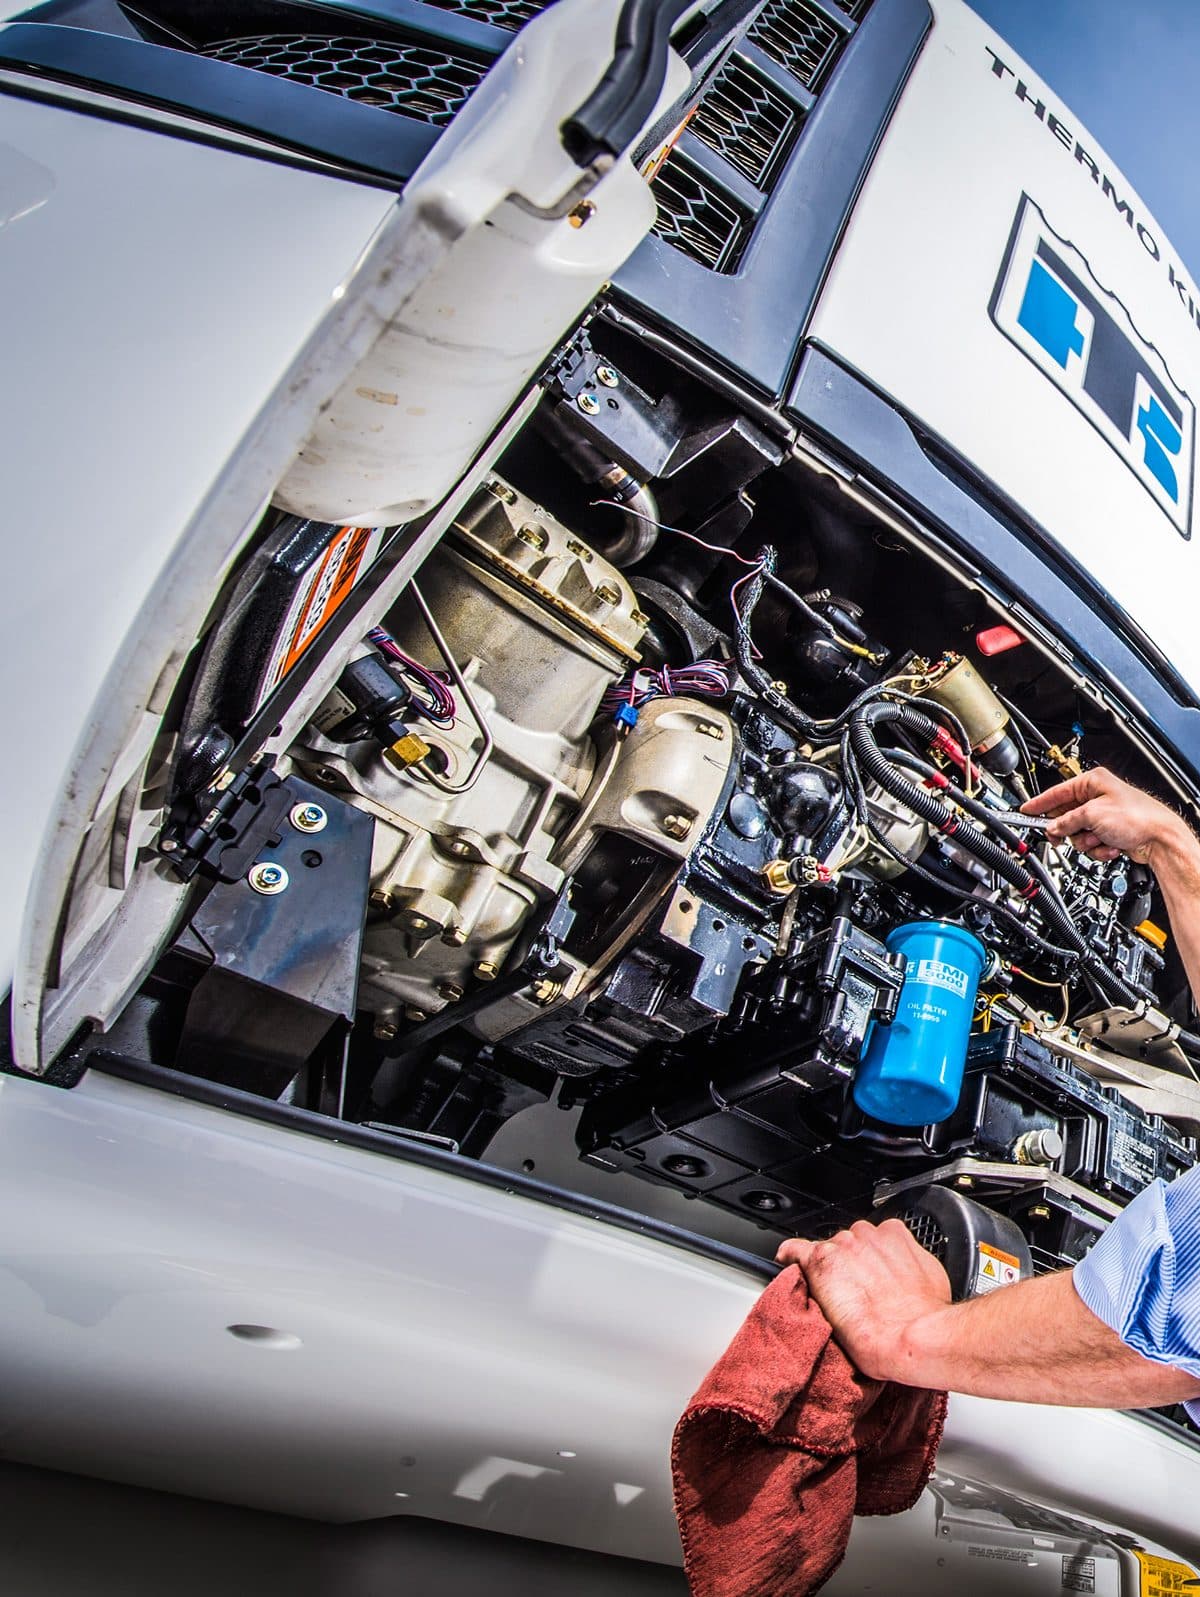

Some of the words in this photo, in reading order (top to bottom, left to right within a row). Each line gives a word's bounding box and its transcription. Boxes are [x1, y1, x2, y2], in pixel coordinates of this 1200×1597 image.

[985, 46, 1160, 261] THERMO
[926, 961, 965, 981] EMI
[907, 1002, 921, 1010] OIL
